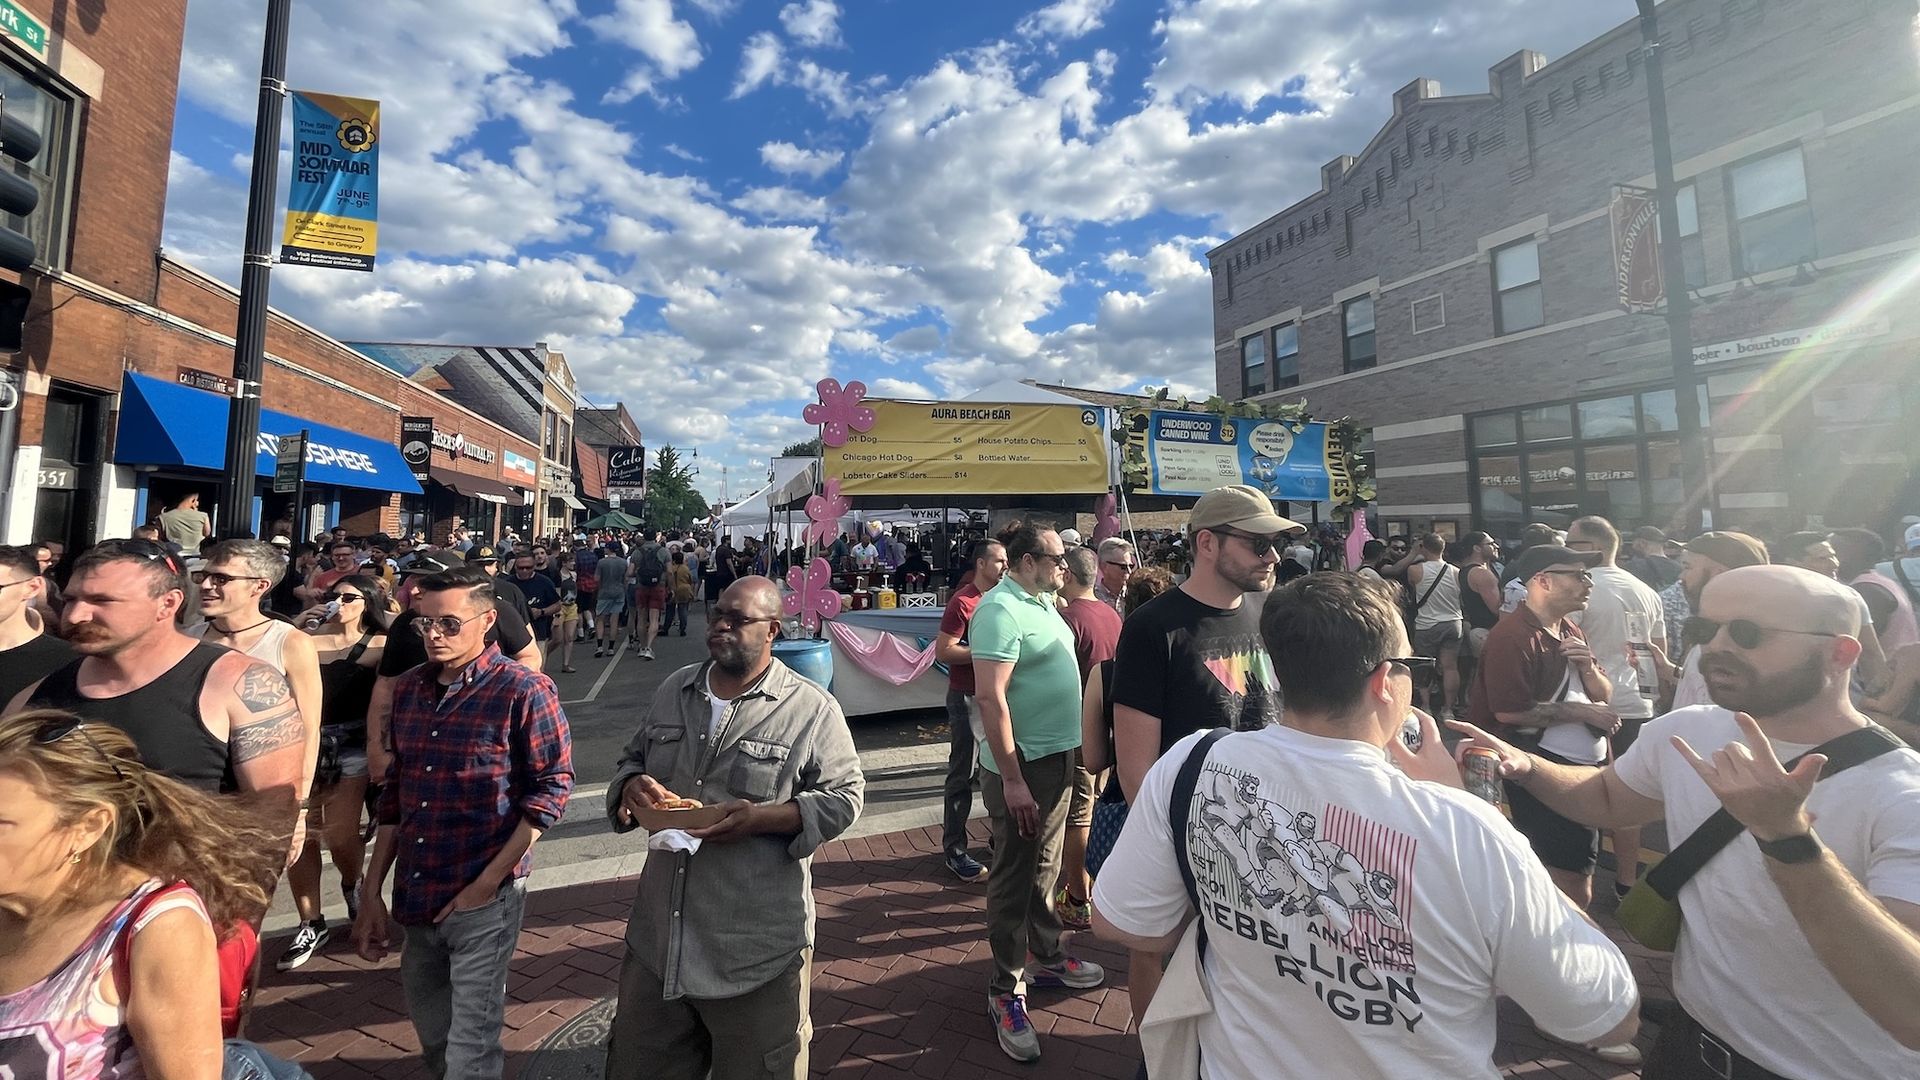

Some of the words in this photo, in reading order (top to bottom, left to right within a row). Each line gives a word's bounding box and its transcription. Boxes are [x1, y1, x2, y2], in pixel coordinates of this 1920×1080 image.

[0, 5, 18, 31] rk
[26, 26, 38, 44] St
[300, 141, 332, 156] MID
[298, 170, 327, 184] FEST
[337, 188, 370, 201] JUNE
[1618, 200, 1656, 308] ANDERSONVILLE
[1736, 336, 1801, 354] bourbon
[180, 373, 195, 385] CALO
[931, 408, 958, 419] AURA
[960, 409, 990, 420] BEACH
[992, 410, 1011, 420] BAR
[1161, 418, 1212, 431] UNDERWOOD
[860, 435, 878, 444] Dog
[1160, 429, 1190, 439] CANNED
[1190, 431, 1210, 440] WINE
[1221, 428, 1234, 438] $12
[977, 437, 1001, 445] House
[1004, 437, 1028, 445] Potato
[1030, 437, 1052, 446] Chips
[610, 447, 642, 468] Calo
[842, 453, 878, 462] Chicago
[879, 453, 895, 461] Hot
[896, 454, 913, 462] Dog
[978, 454, 1006, 462] Bottled
[1327, 428, 1350, 498] BEVVIES
[842, 472, 875, 480] Lobster
[899, 471, 927, 480] Sliders
[954, 471, 968, 479] $14
[911, 510, 941, 519] WYNK
[1191, 852, 1216, 873] EST
[1364, 931, 1413, 955] LOS
